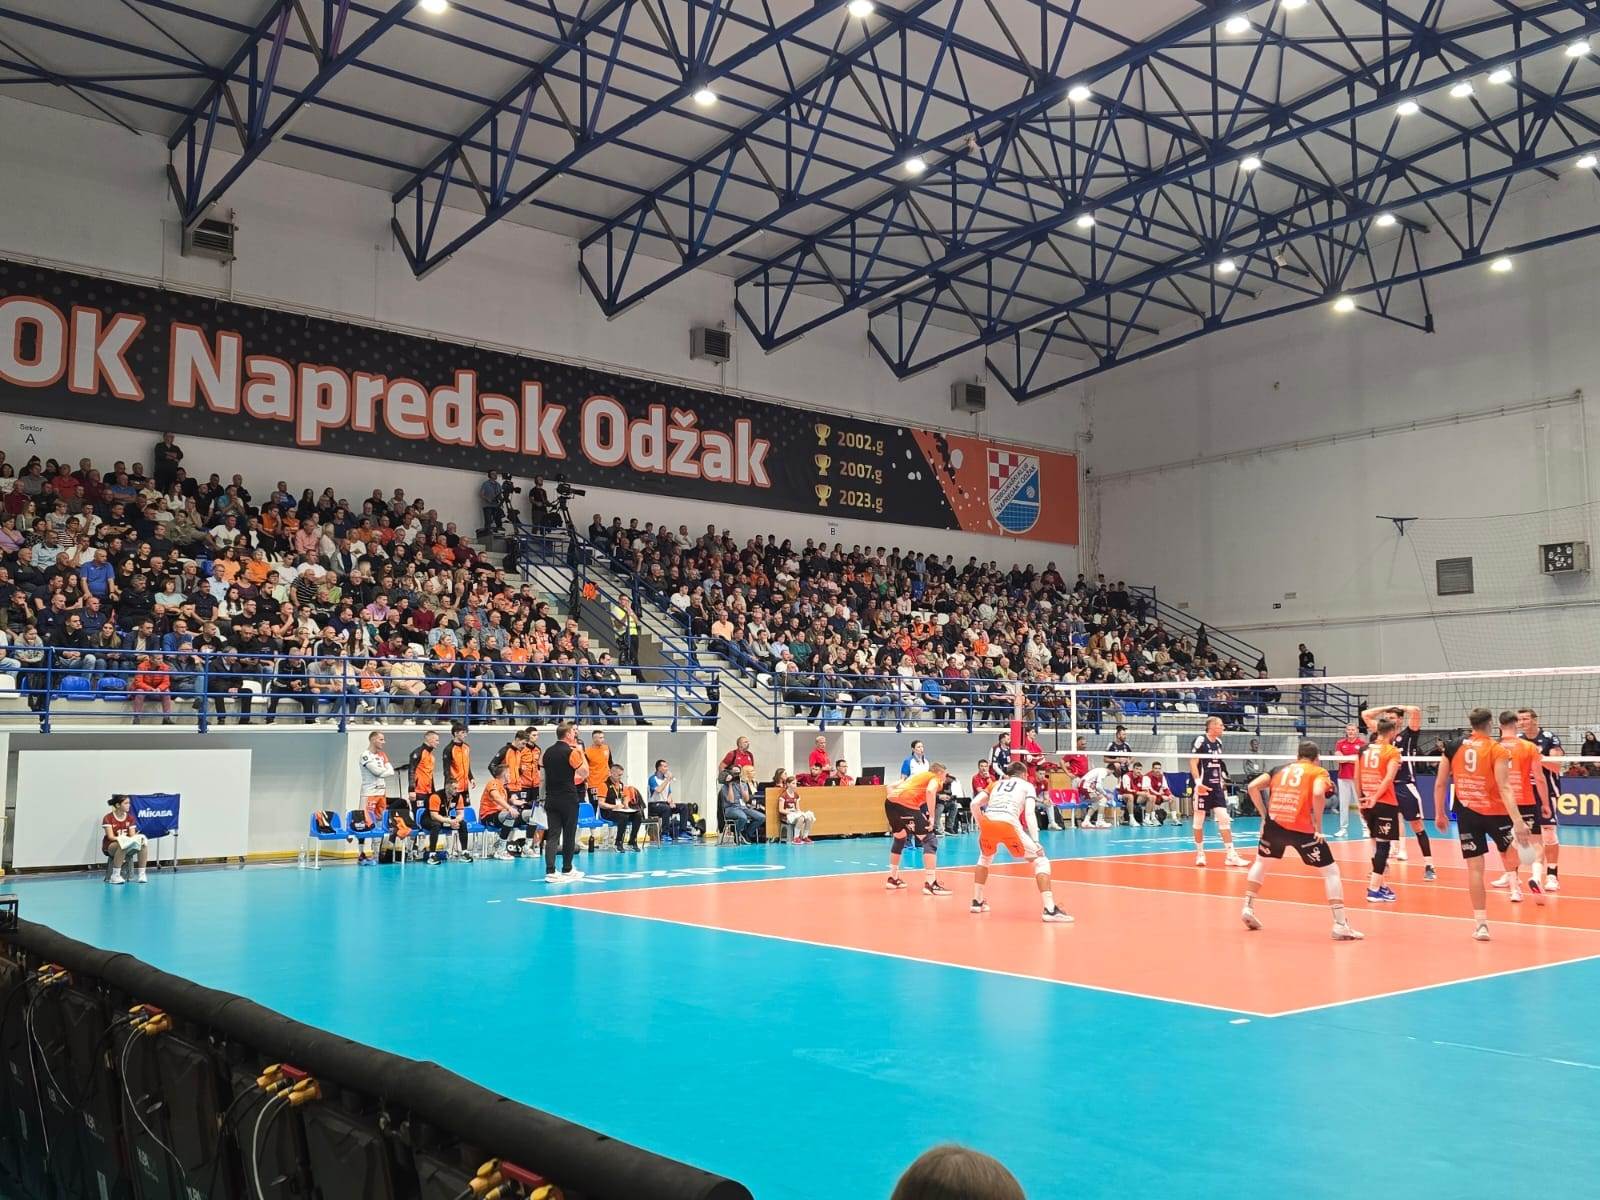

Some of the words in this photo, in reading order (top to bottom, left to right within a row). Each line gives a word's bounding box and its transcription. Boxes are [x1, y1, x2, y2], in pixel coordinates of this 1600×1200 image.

[0, 296, 145, 401] OK
[168, 322, 566, 460] Napredak
[581, 395, 772, 488] Odžak
[25, 433, 36, 445] A
[838, 431, 884, 456] 2002.g
[840, 460, 882, 484] 2007.g
[839, 489, 884, 513] 2023.g
[830, 527, 836, 536] B
[1363, 750, 1380, 769] 15
[1464, 748, 1478, 773] 9
[996, 780, 1018, 793] 19
[1280, 765, 1305, 787] 13
